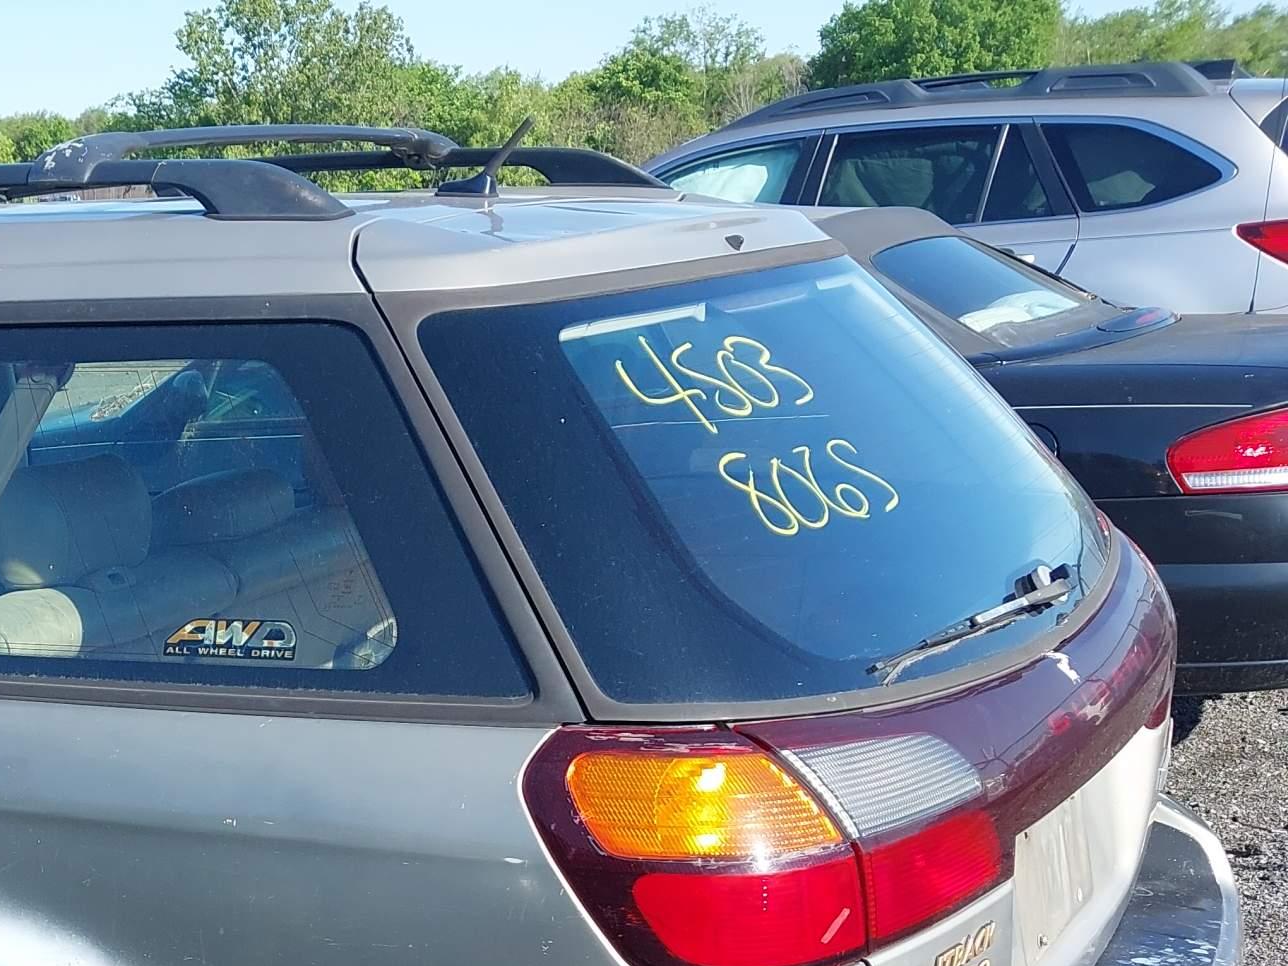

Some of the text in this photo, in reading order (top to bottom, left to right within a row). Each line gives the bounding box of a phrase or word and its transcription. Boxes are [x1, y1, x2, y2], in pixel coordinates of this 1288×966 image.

[615, 335, 814, 433] 4503
[718, 439, 900, 536] 8065
[166, 619, 297, 648] AWD
[166, 646, 293, 659] ALL WHEEL DRIVE
